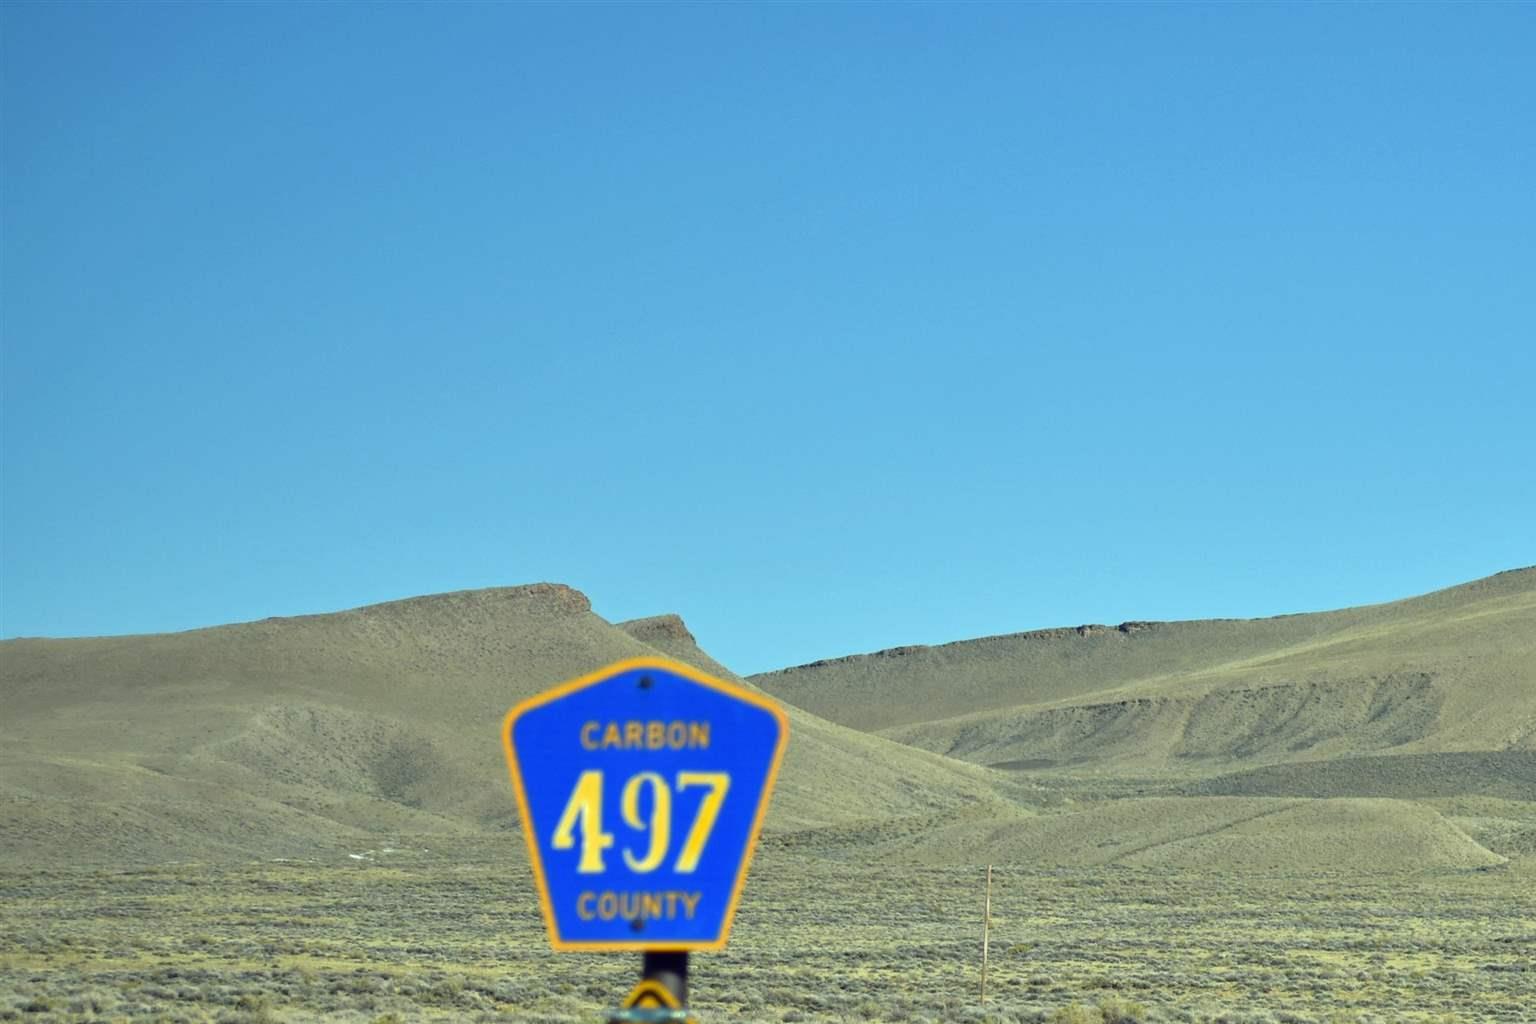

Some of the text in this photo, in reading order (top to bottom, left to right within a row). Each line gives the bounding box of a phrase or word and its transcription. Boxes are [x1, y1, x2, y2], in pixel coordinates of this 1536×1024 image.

[581, 721, 711, 750] CARBON
[551, 770, 731, 874] 497
[578, 892, 701, 921] COUNTY
